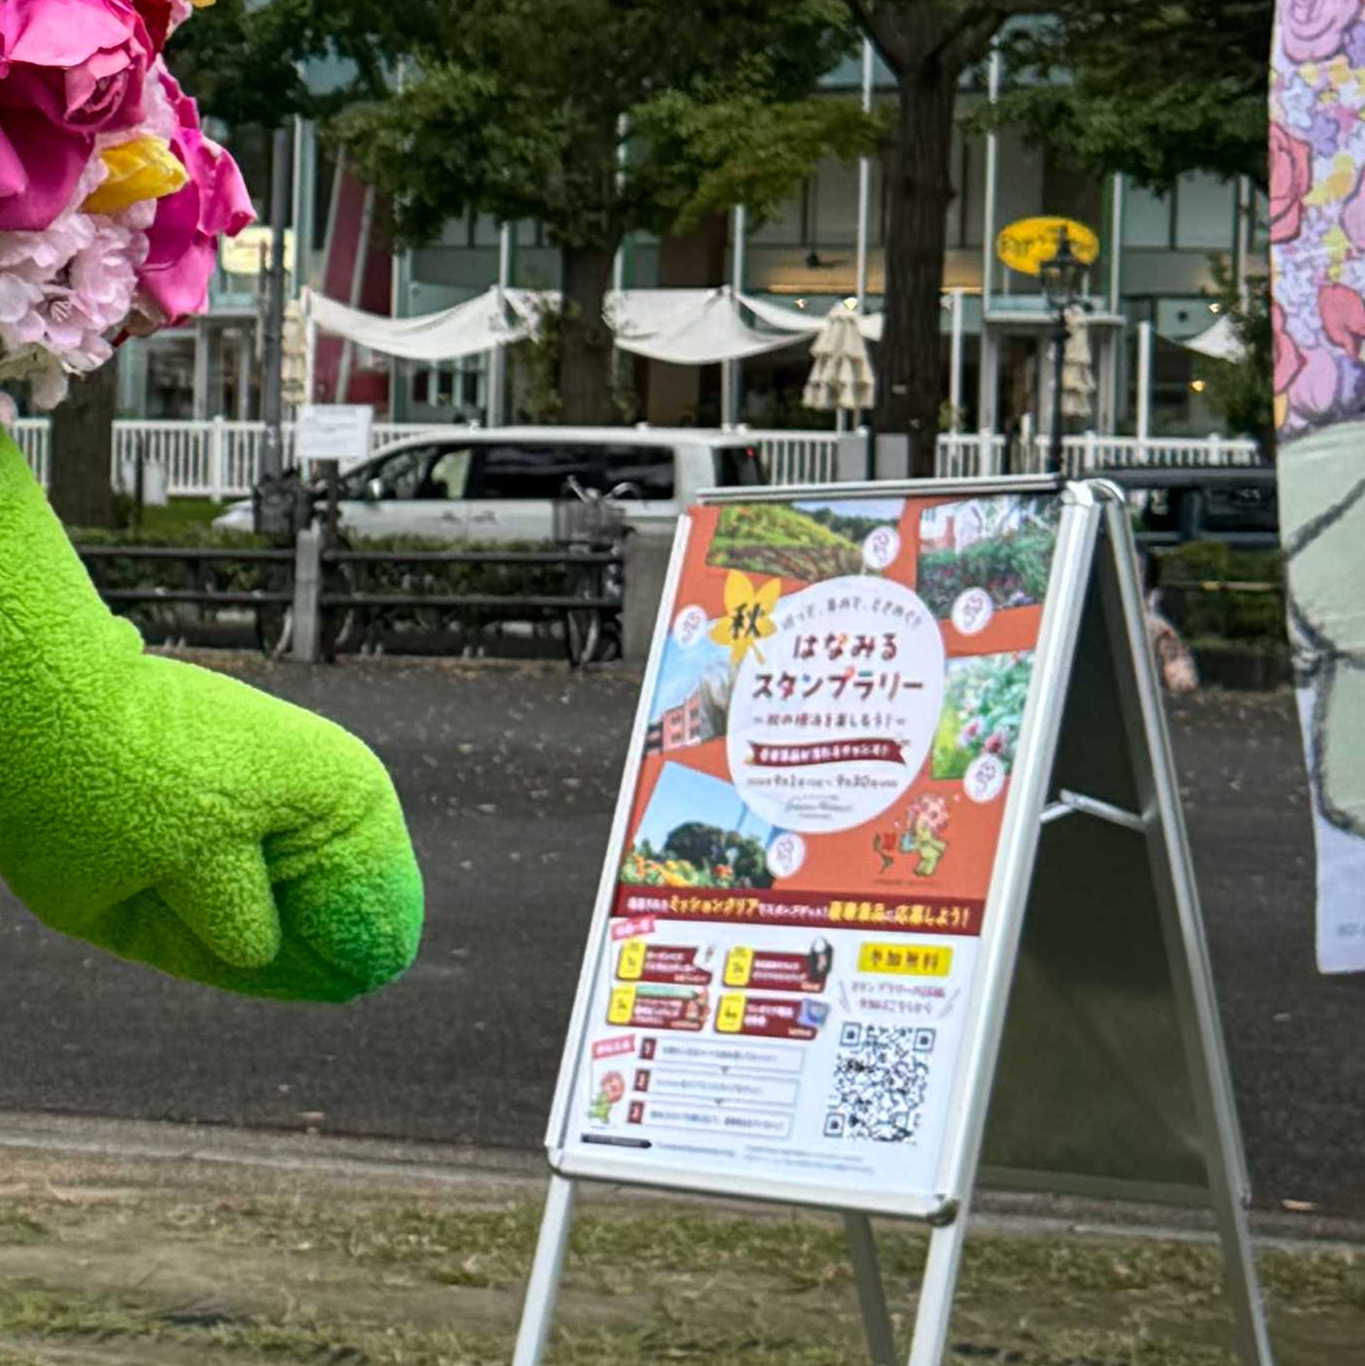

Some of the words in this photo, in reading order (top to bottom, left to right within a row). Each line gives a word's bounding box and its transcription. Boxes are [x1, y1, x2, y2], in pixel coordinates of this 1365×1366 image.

[731, 602, 764, 640] 秋
[793, 632, 898, 661] はなみる
[752, 666, 924, 701] スタンプラリー
